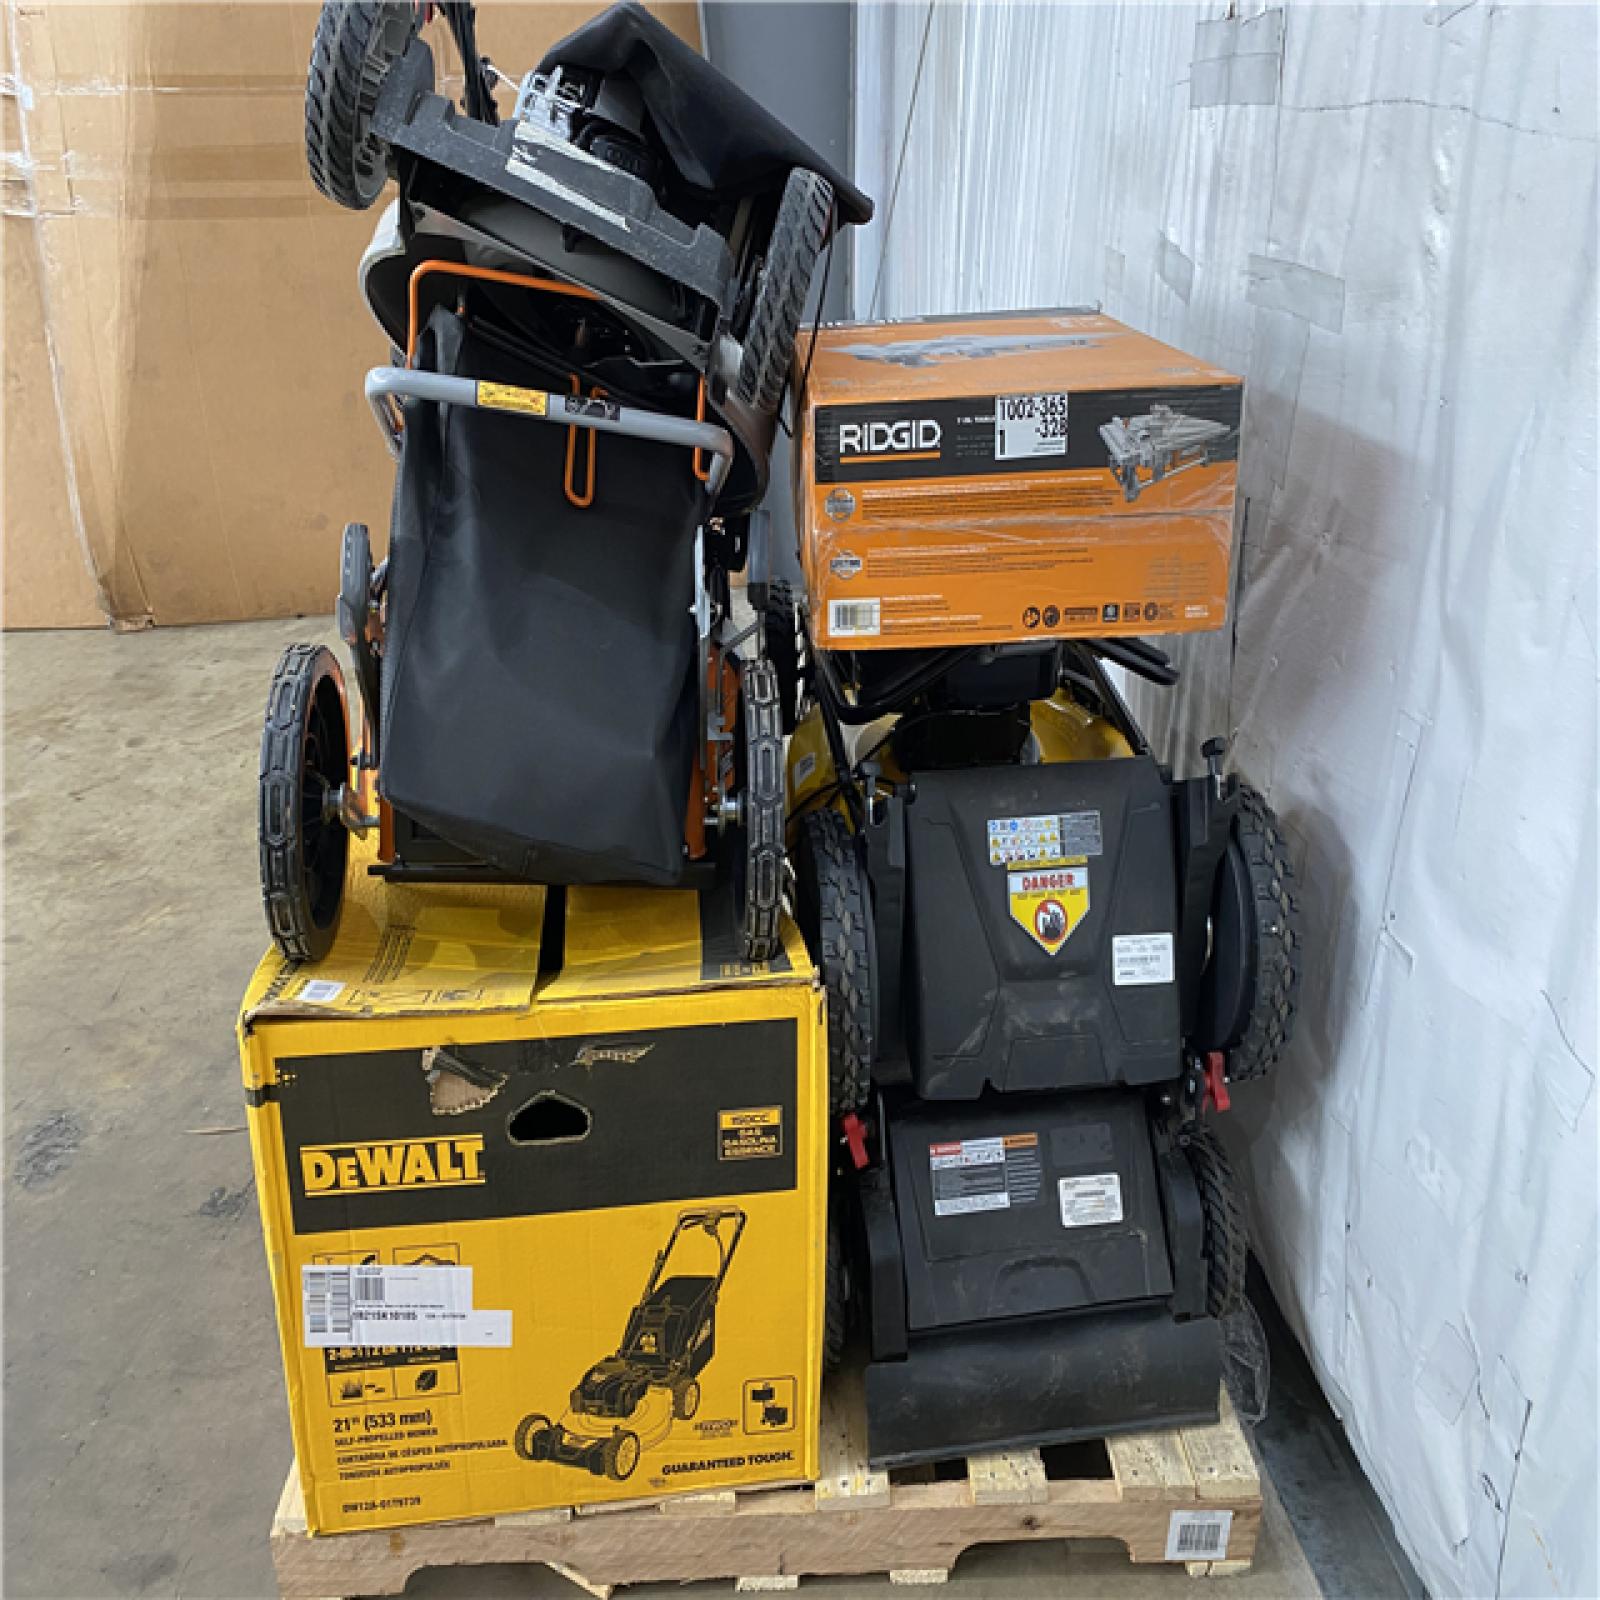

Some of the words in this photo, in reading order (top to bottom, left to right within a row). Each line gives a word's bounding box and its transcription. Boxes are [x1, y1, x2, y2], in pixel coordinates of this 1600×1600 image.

[999, 395, 1066, 420] 1002-365
[839, 420, 942, 453] RIDGID
[1023, 874, 1073, 891] DANGER
[364, 1412, 396, 1432] (533
[400, 1408, 432, 1426] mm)
[662, 1457, 746, 1475] GUARANTEED
